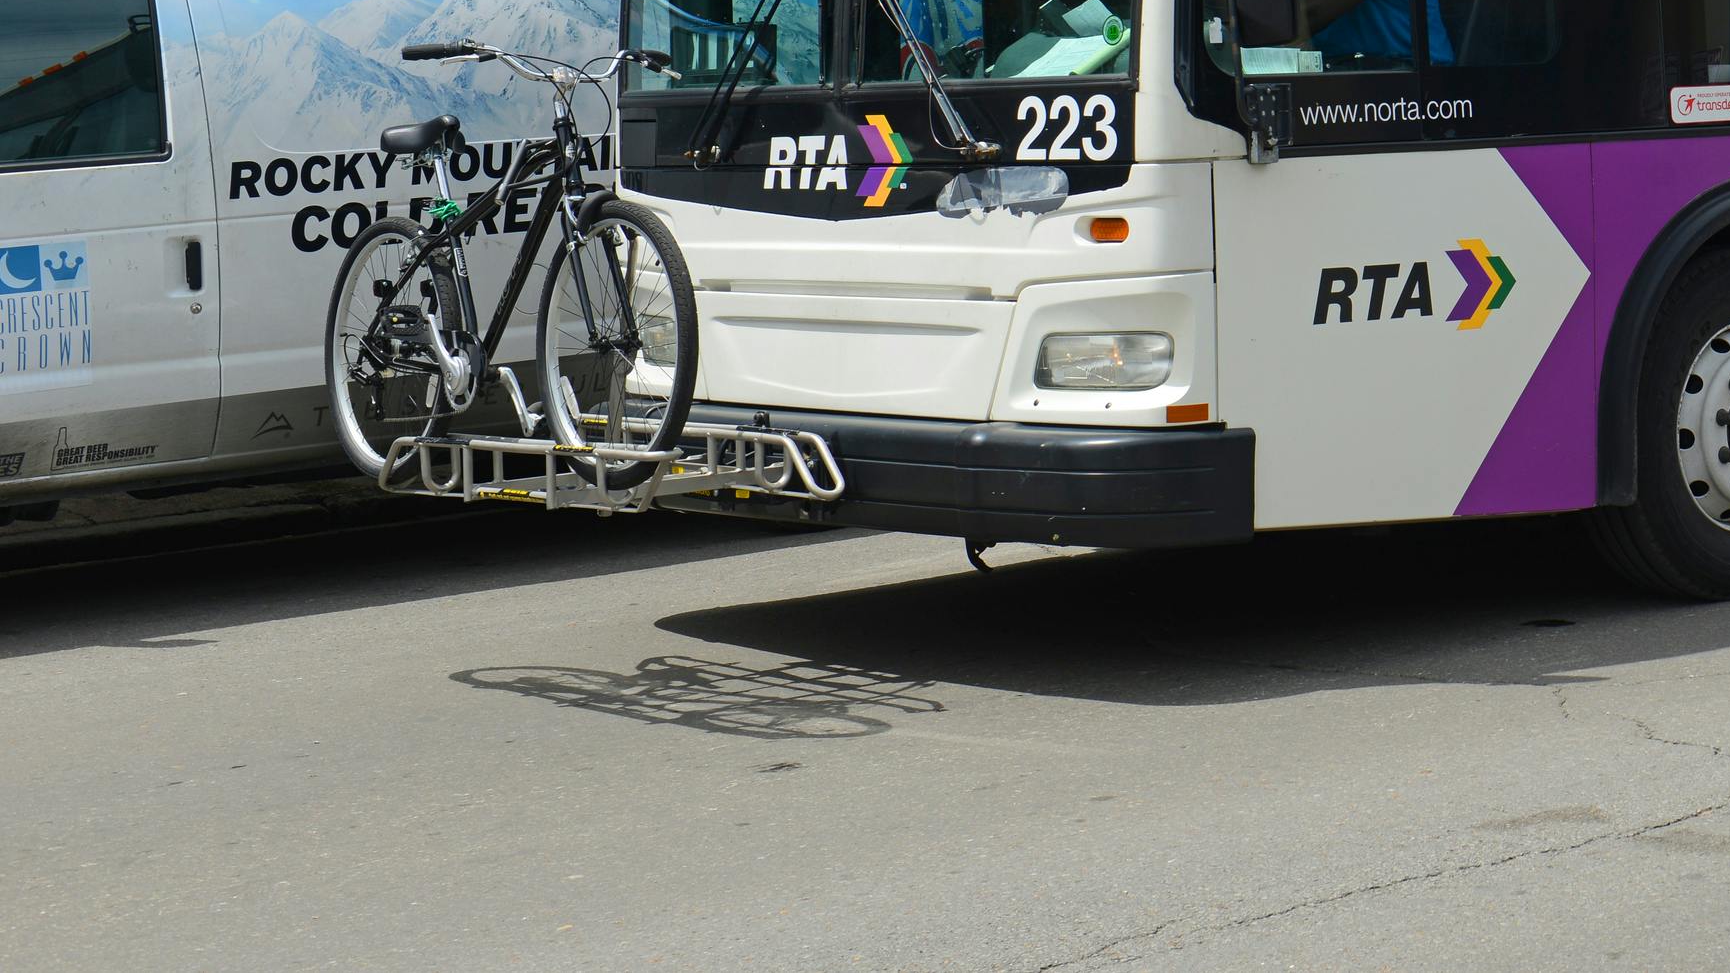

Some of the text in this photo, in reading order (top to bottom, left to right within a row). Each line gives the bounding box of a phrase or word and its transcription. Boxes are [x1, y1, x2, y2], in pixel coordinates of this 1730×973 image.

[1015, 94, 1118, 162] 223
[1300, 97, 1473, 126] www.norta.com
[229, 152, 399, 200] ROCKY
[763, 134, 848, 191] RTA
[1313, 261, 1434, 325] RTA
[56, 454, 84, 466] GREAT
[85, 445, 156, 462] RESPONSIBILITY
[57, 443, 108, 458] GREAT BEER
